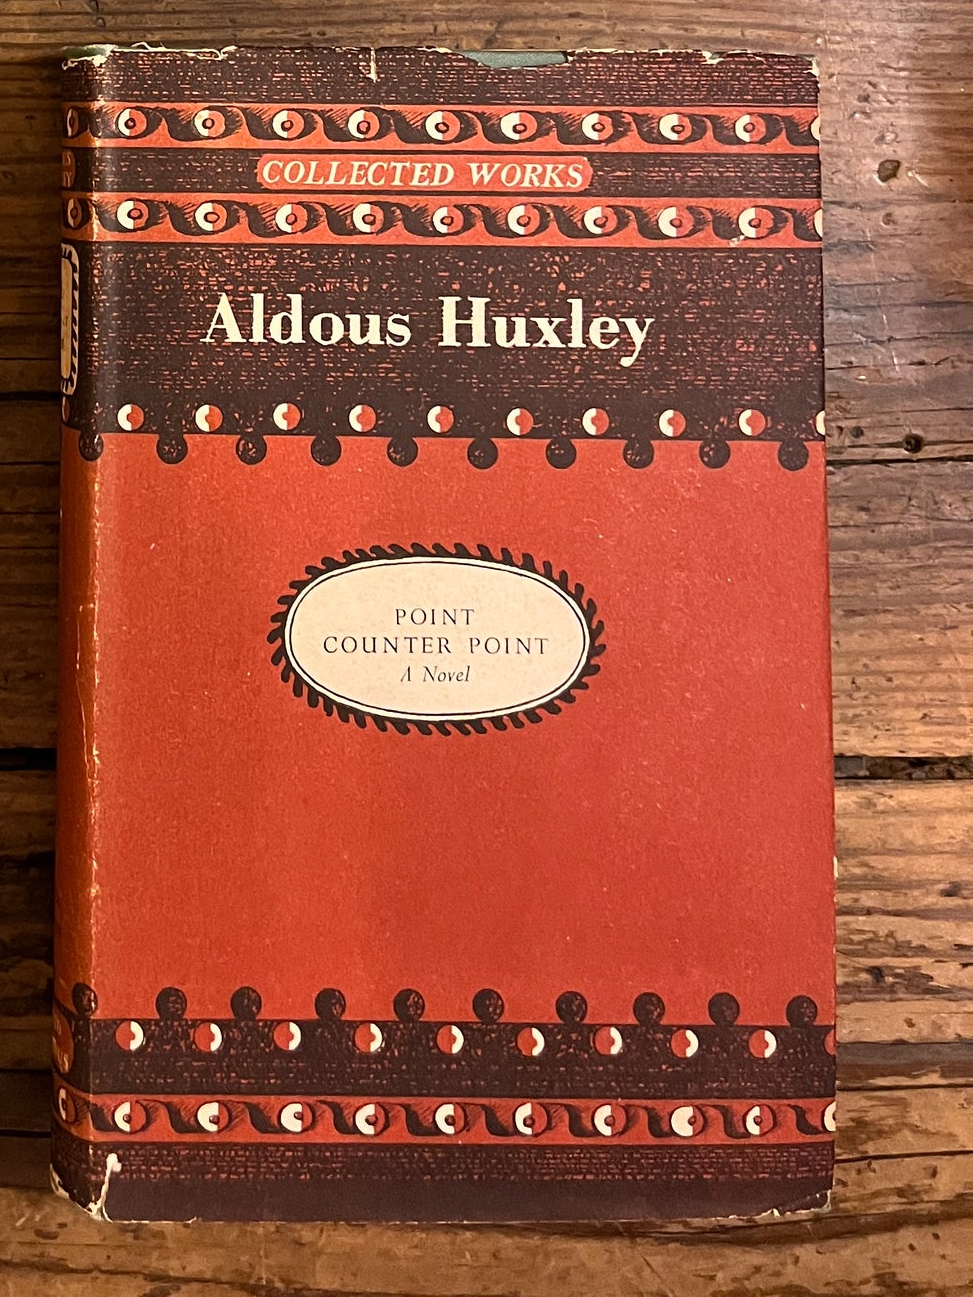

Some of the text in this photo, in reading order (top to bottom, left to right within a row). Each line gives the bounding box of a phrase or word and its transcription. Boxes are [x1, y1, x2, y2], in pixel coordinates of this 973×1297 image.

[263, 160, 583, 188] COLLECTED WORKS
[199, 291, 656, 368] Aldous Huxley
[395, 607, 475, 626] POINT
[323, 635, 549, 655] COUNTER POINT
[399, 664, 471, 683] A Novel
